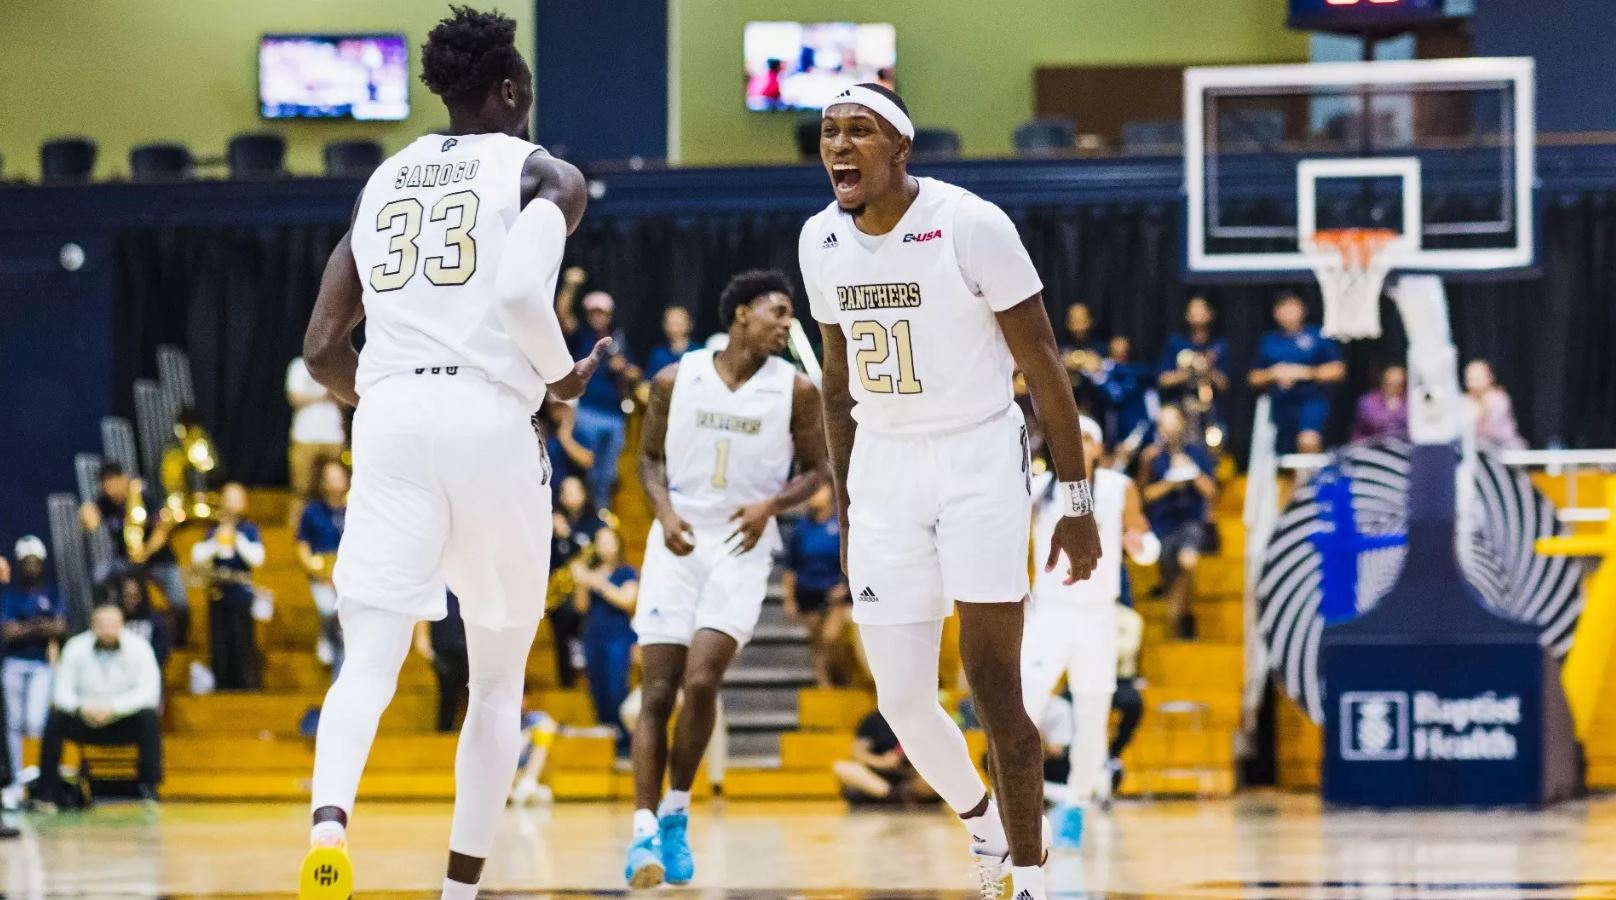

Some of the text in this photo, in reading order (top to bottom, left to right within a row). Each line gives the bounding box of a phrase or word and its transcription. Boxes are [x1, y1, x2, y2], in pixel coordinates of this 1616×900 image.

[395, 159, 480, 189] SANOGO
[370, 189, 480, 293] 33
[837, 282, 921, 311] PANTHERS
[851, 319, 923, 394] 21
[710, 438, 731, 490] 1
[1412, 691, 1521, 732] Baptist
[1412, 726, 1517, 760] Health
